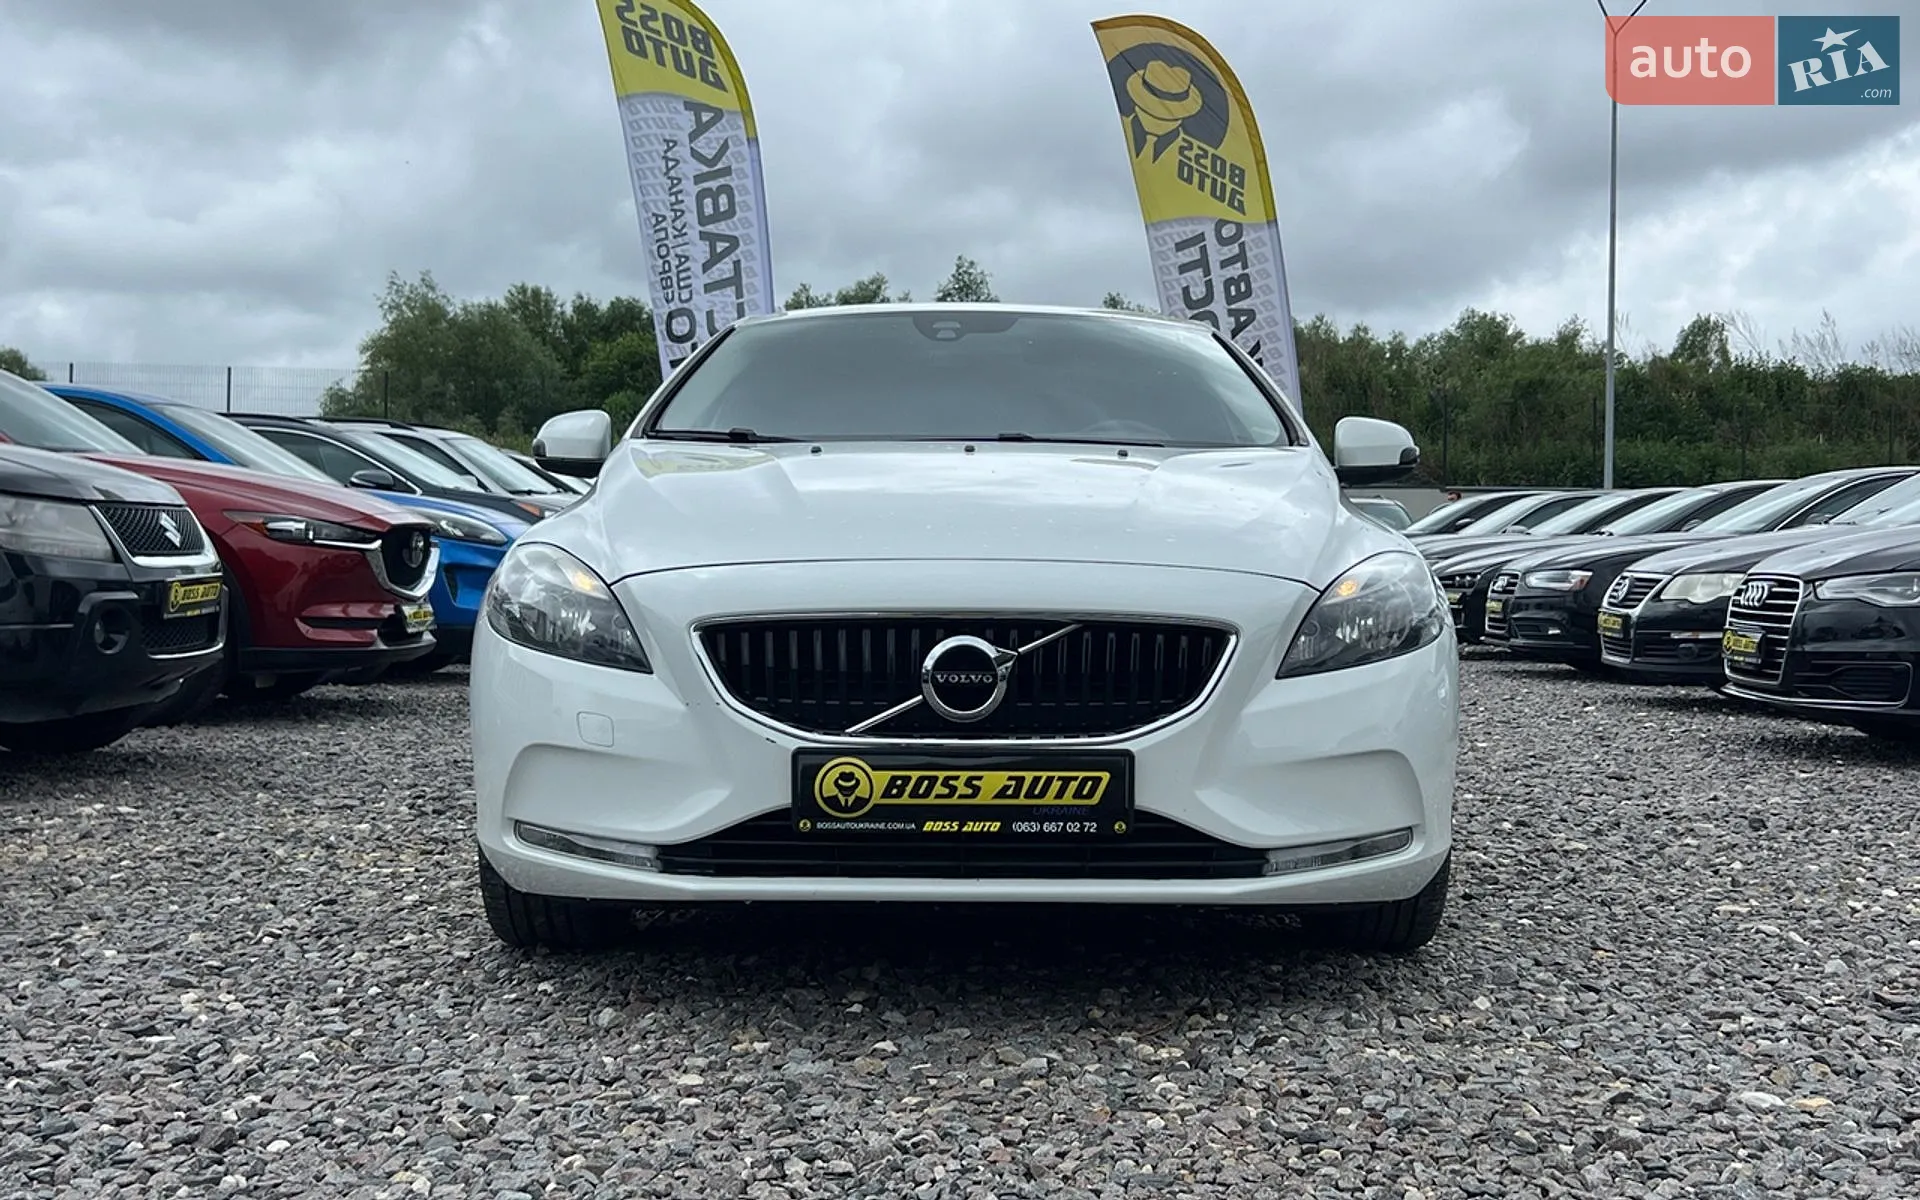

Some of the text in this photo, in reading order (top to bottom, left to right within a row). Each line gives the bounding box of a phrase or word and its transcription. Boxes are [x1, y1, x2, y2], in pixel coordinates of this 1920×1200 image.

[935, 674, 993, 683] VOLVO
[880, 775, 1103, 800] BOSS AUTO
[1032, 807, 1090, 815] UKRAINE
[922, 821, 958, 832] BOSS
[962, 821, 1001, 832] AUTO
[1012, 822, 1041, 833] (063)
[1043, 822, 1064, 832] 667
[1066, 822, 1081, 832] 02
[1083, 822, 1098, 832] 72
